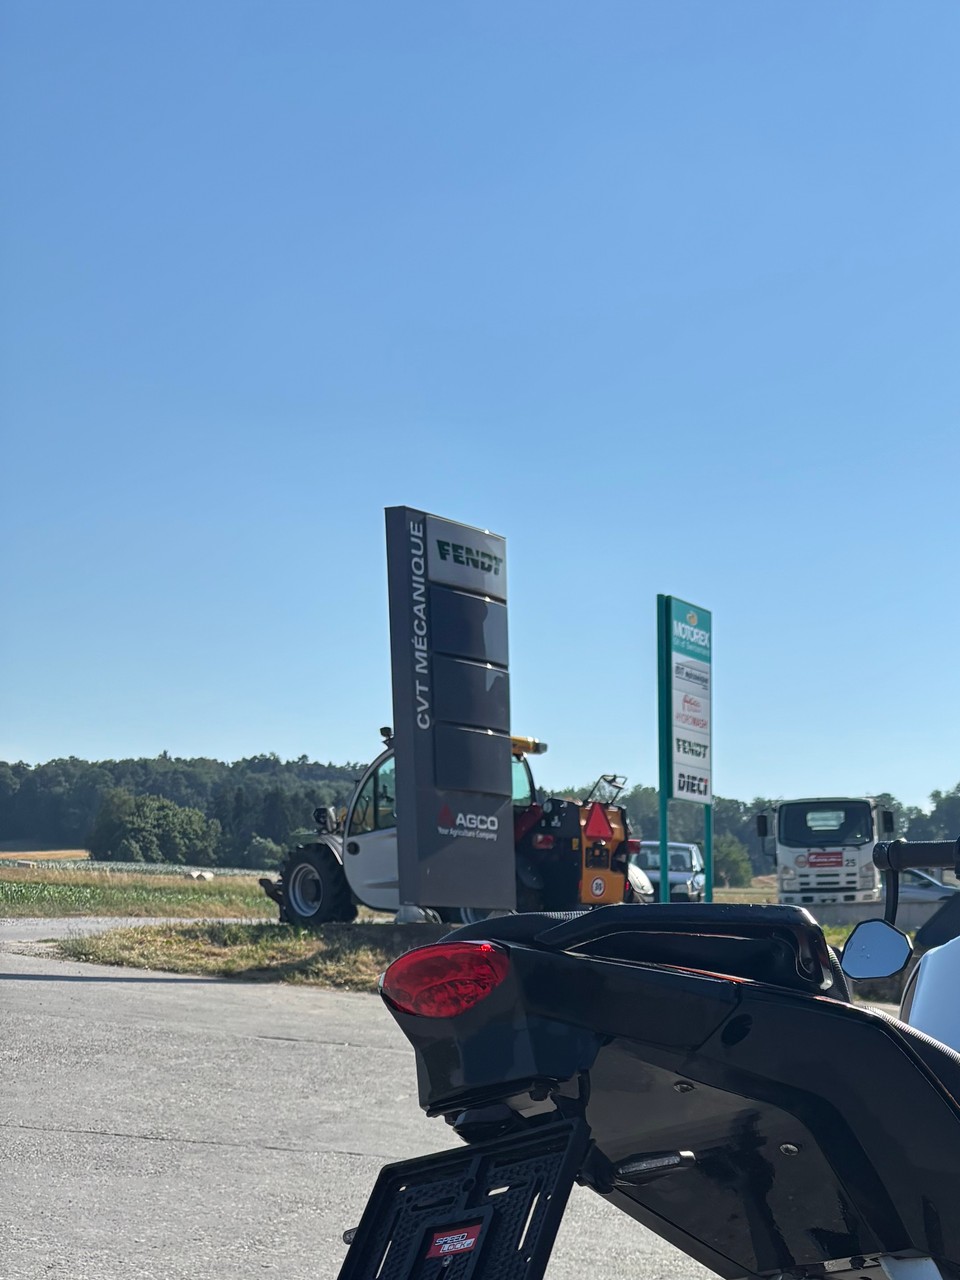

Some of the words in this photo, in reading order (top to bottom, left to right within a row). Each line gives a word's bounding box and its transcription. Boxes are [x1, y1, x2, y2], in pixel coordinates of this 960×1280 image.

[436, 539, 503, 576] FENDT
[410, 520, 429, 674] MÉCANIQUE
[672, 620, 710, 648] MOTOREX
[416, 680, 430, 730] CVT
[675, 737, 708, 759] FENDT
[455, 813, 498, 830] AGCO
[435, 1233, 467, 1246] SPEED
